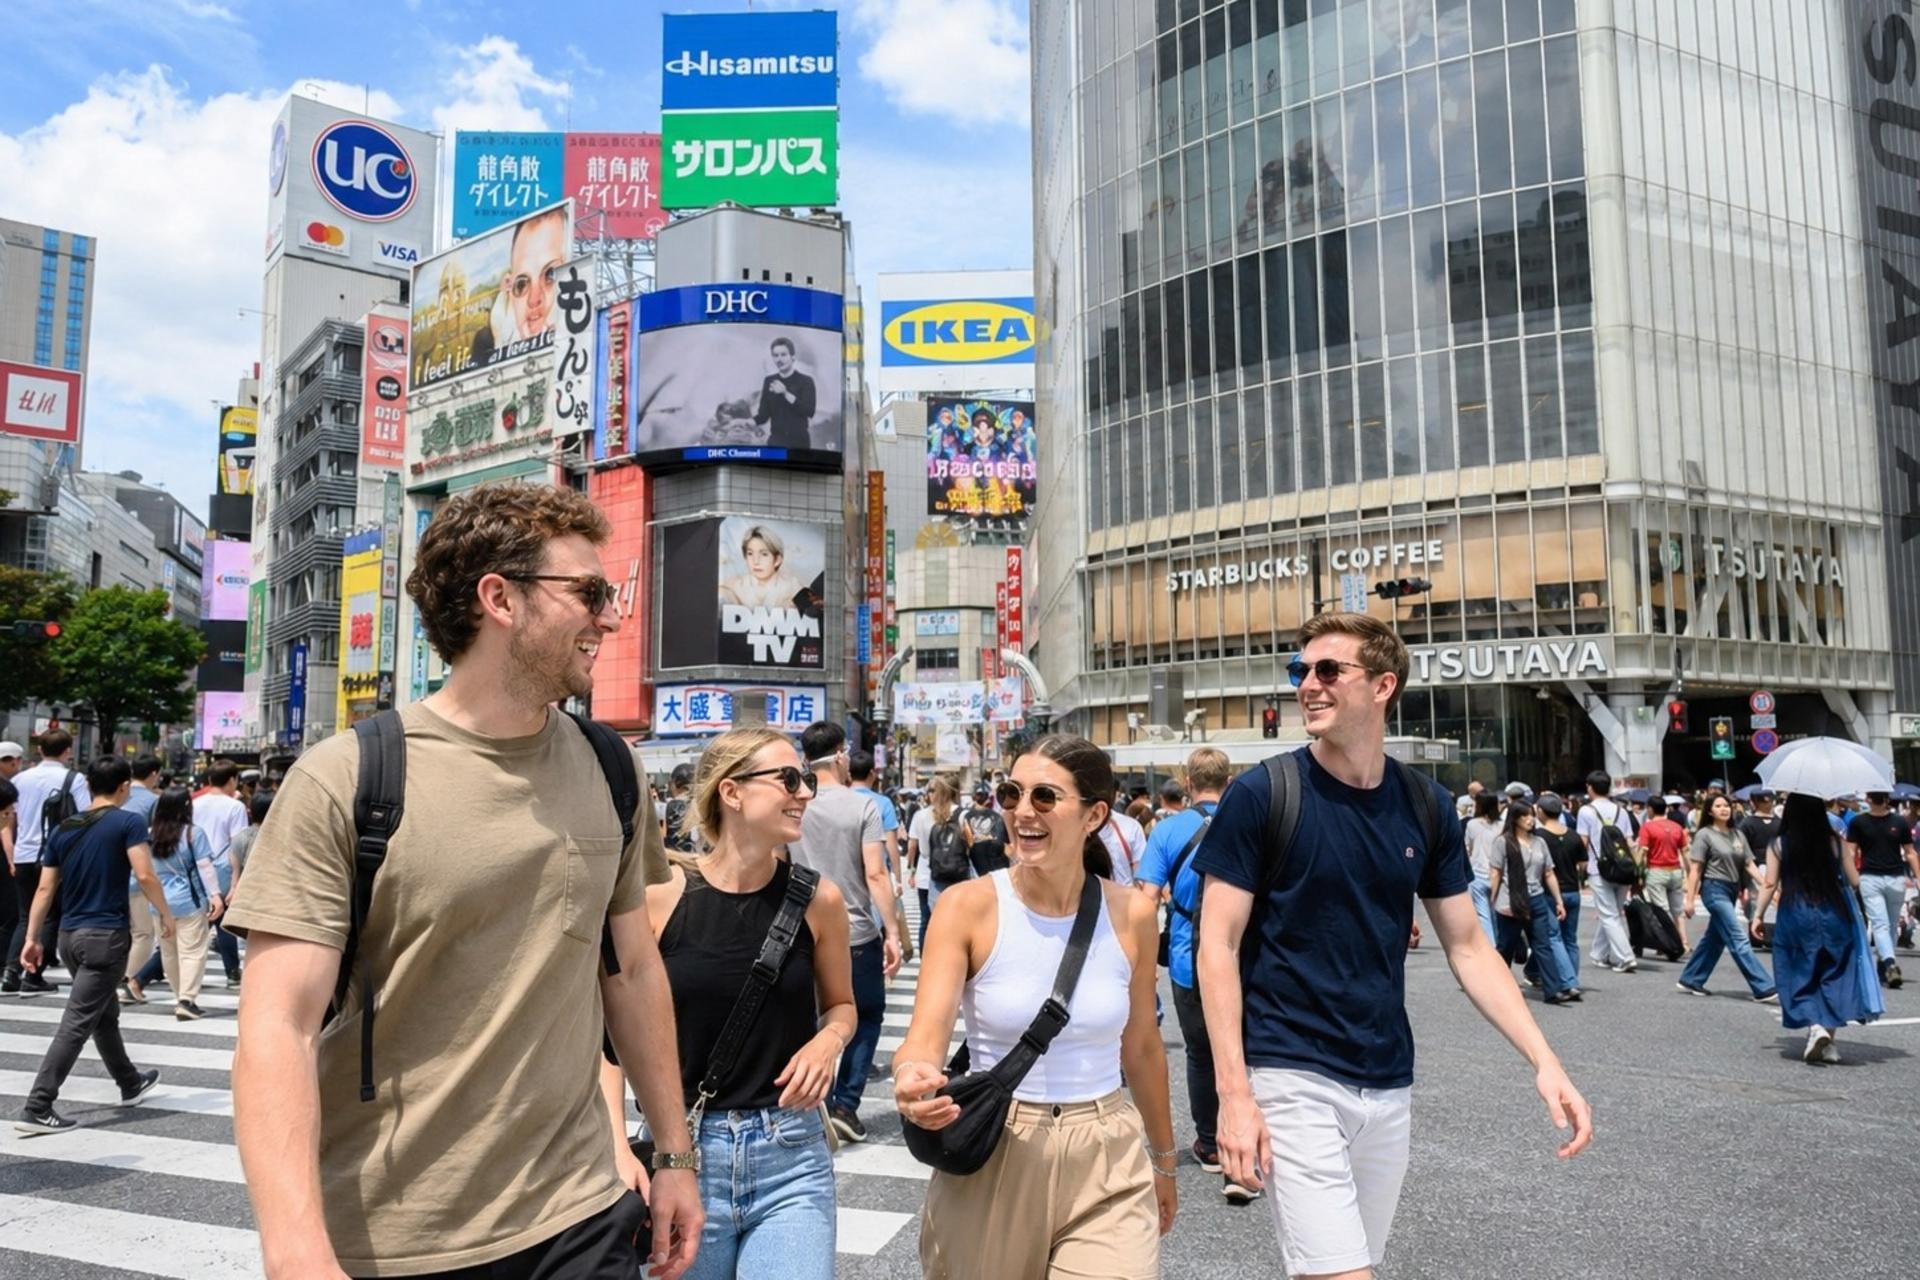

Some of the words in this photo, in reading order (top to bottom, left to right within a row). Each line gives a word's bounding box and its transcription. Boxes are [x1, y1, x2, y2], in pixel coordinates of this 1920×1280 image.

[665, 50, 833, 76] Hisamitsu
[477, 154, 540, 182] 龍角散
[585, 156, 649, 183] 龍角散
[672, 137, 827, 178] サロンパス
[469, 182, 549, 208] ダイレクト
[578, 183, 658, 209] ダイレクト
[377, 240, 418, 262] VISA
[704, 290, 768, 314] DHC
[900, 318, 1032, 344] IKEA
[707, 449, 727, 458] DHC
[1166, 554, 1310, 592] STARBUCKS
[1331, 540, 1444, 571] COFFEE
[1703, 542, 1844, 588] TSUTAYA
[747, 634, 797, 664] TV
[1413, 641, 1607, 681] TSUTAYA
